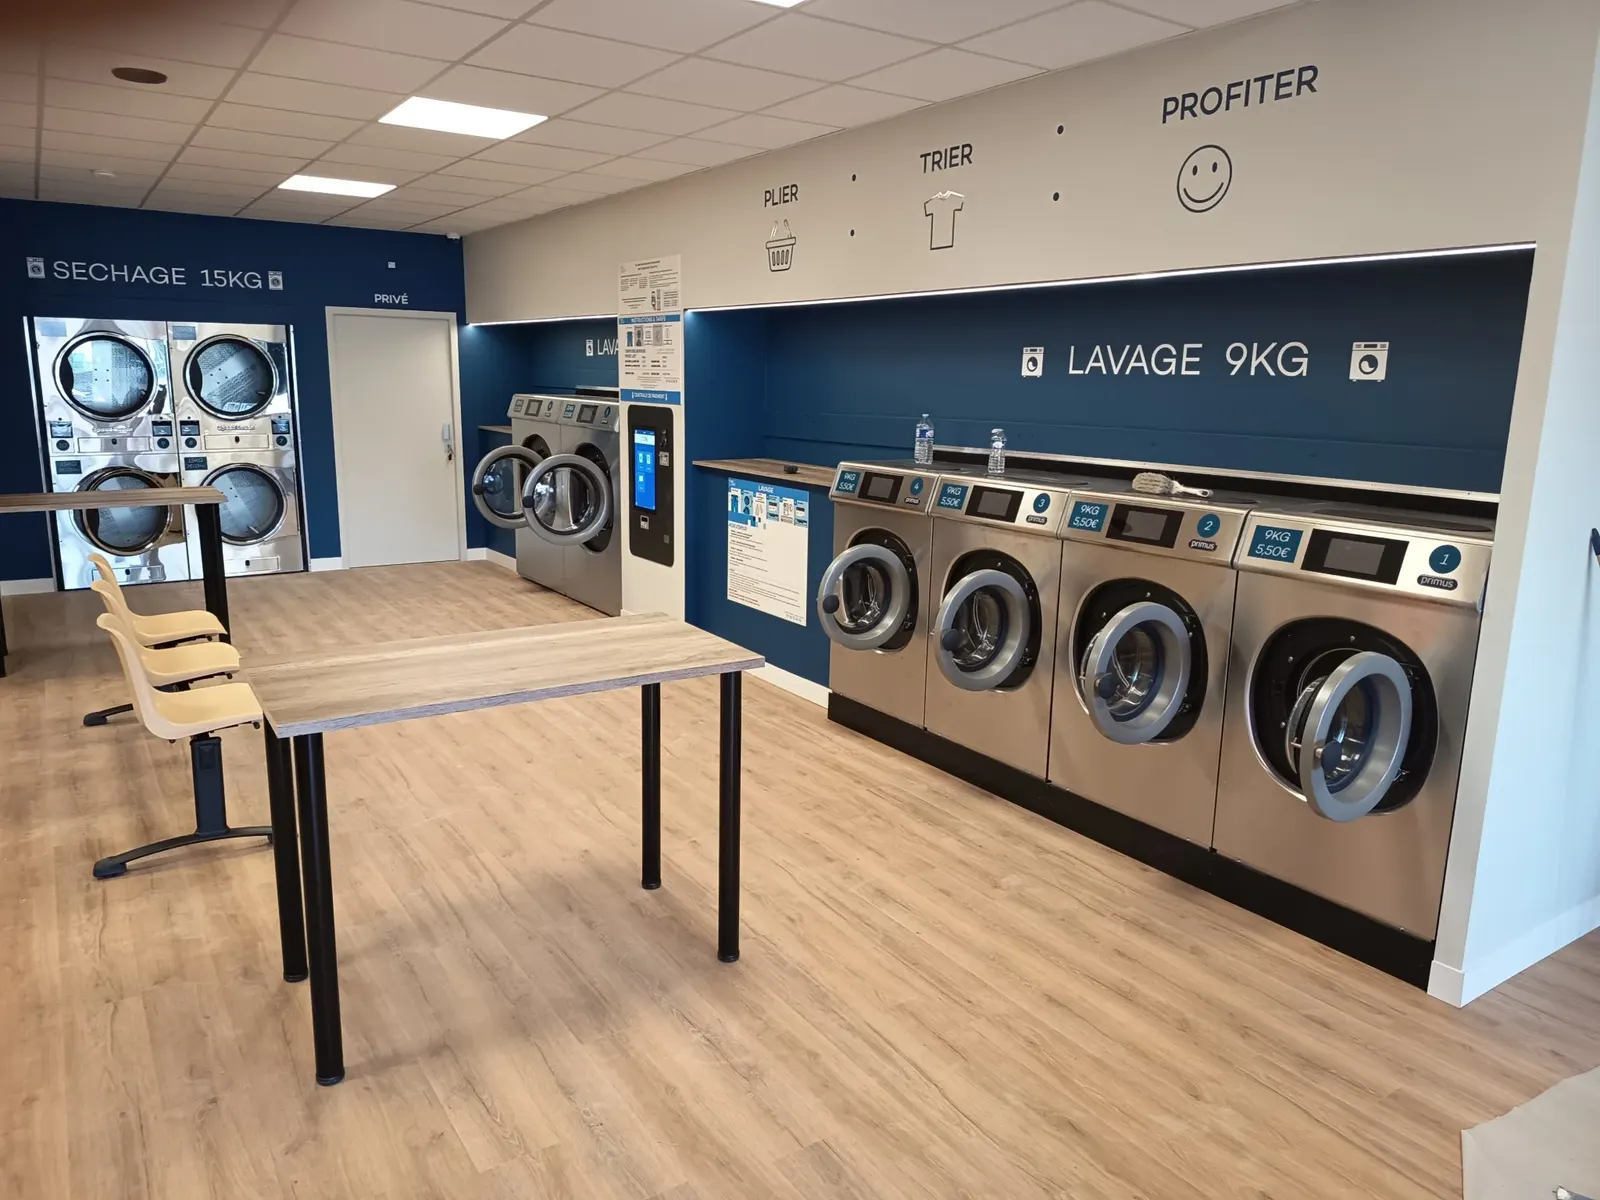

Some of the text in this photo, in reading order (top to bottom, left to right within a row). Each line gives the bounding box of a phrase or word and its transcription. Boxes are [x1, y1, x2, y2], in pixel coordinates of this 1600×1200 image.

[1162, 65, 1319, 124] PROFITER
[920, 143, 973, 174] TRIER
[764, 183, 799, 207] PLIER
[53, 260, 263, 289] SECHAGE 15KG
[374, 292, 409, 305] PRIVÉ
[1068, 341, 1310, 377] LAVAGE 9KG
[914, 482, 919, 490] 4
[946, 486, 962, 496] 9KG
[940, 496, 961, 507] 5,50€
[1038, 499, 1045, 508] 3
[1080, 504, 1100, 516] 9KG
[1027, 515, 1046, 524] primus
[1073, 516, 1099, 529] 5,50€
[1204, 521, 1213, 531] 2
[1264, 529, 1292, 543] 9KG
[1190, 540, 1215, 550] primus
[1255, 543, 1291, 559] 5,50€
[1439, 554, 1449, 566] 1
[1420, 575, 1455, 590] primus
